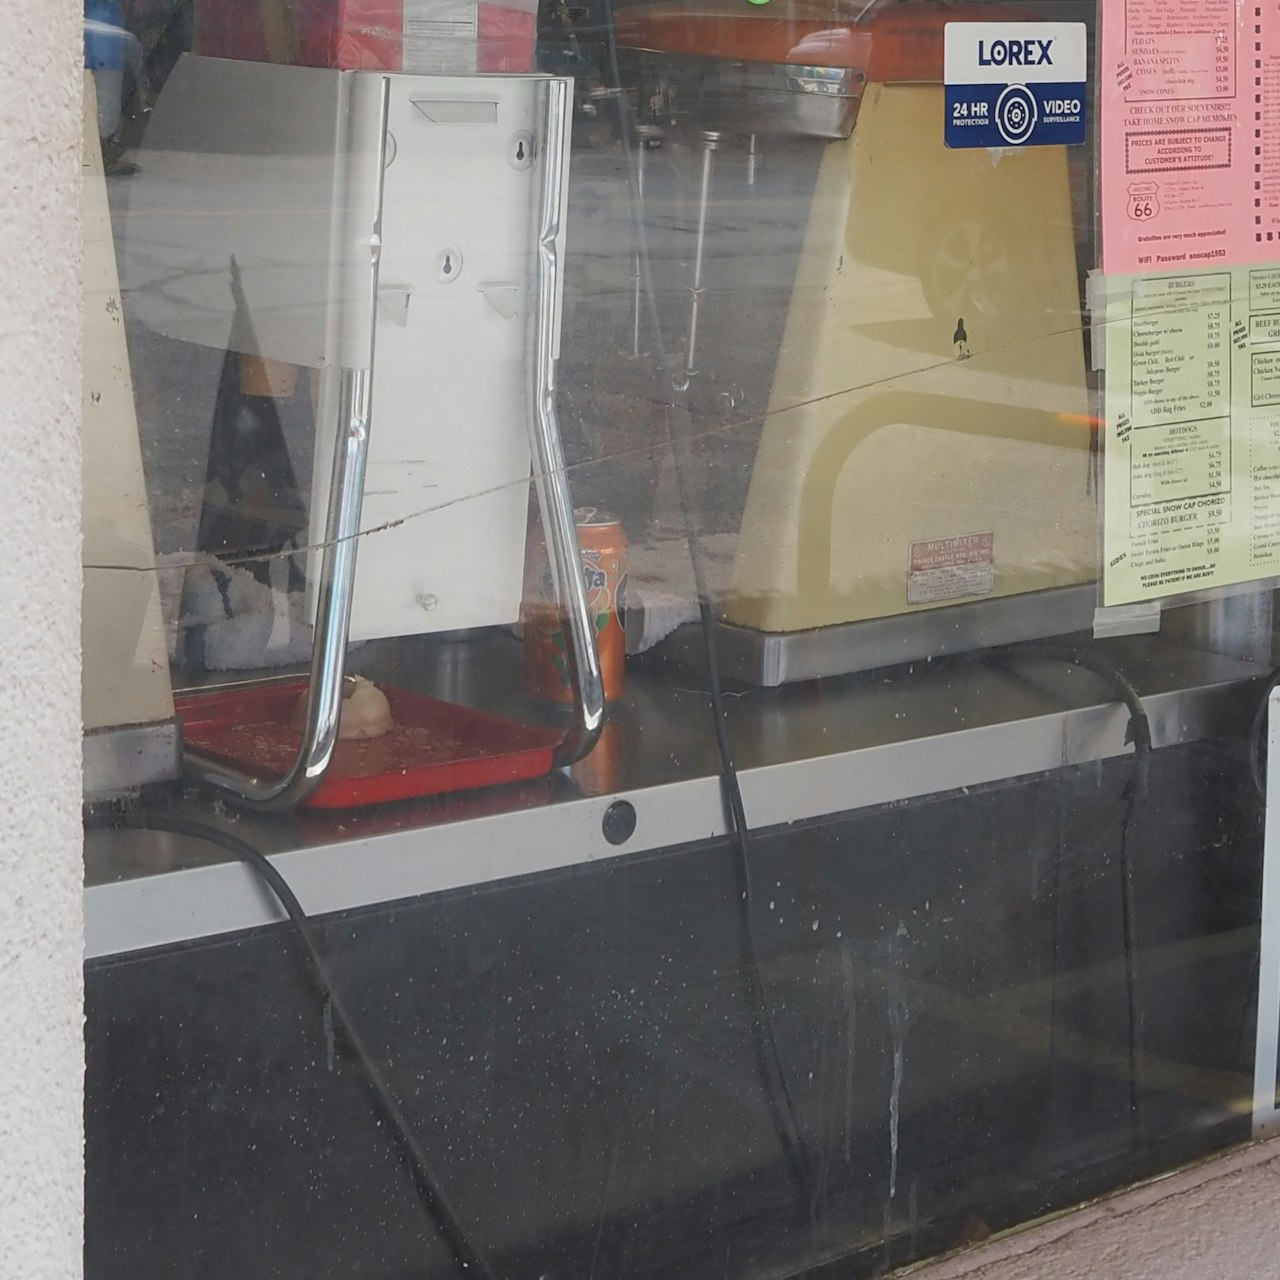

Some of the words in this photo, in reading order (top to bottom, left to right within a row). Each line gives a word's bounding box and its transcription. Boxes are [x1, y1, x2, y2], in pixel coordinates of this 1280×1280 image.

[978, 40, 1053, 66] LOREX
[953, 103, 968, 117] 24
[971, 102, 988, 116] HR
[1043, 100, 1081, 113] VIDEO
[1201, 114, 1237, 122] MEMORIES
[1145, 156, 1182, 165] CUSTOMER'S
[1134, 203, 1152, 217] 66
[1157, 253, 1186, 262] Password
[1189, 250, 1226, 260] snocap1953
[1255, 320, 1270, 328] BEEF
[1170, 426, 1198, 436] HOTDOGS
[1136, 509, 1160, 517] SPECIAL
[1163, 505, 1182, 513] SNOW
[1184, 503, 1196, 511] CAP
[1198, 498, 1225, 509] CHORIZO
[1138, 518, 1169, 529] CHORIZO
[1171, 513, 1198, 524] BURGER
